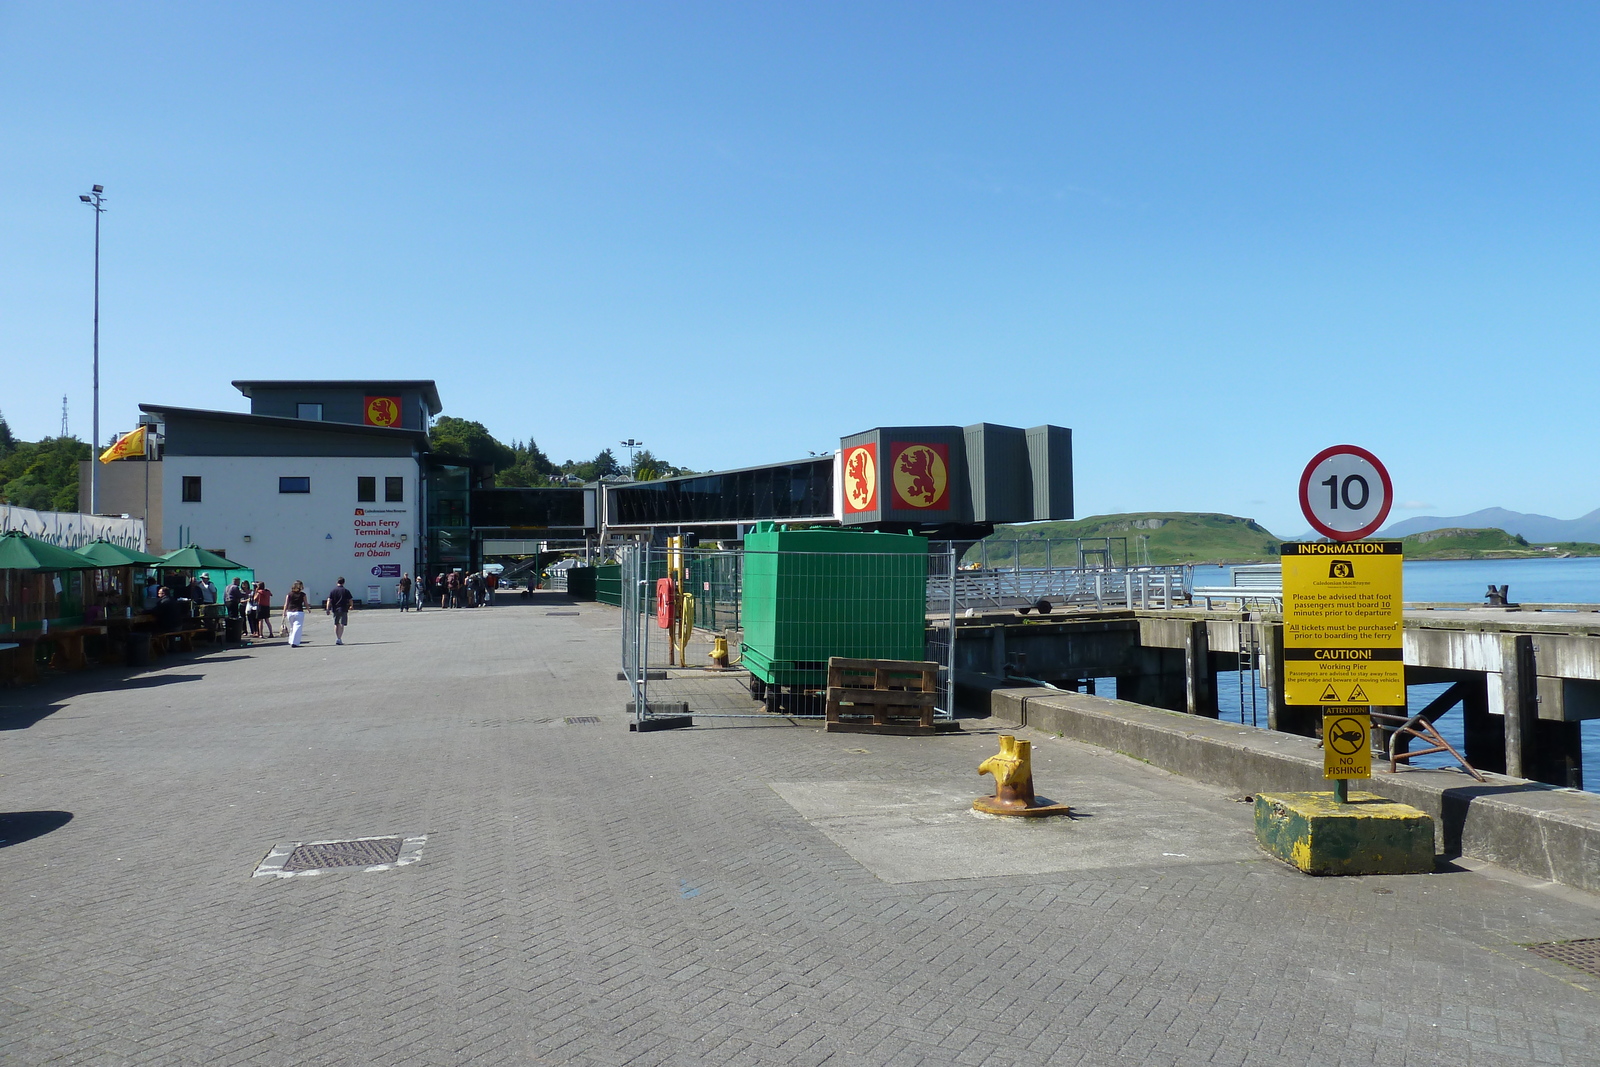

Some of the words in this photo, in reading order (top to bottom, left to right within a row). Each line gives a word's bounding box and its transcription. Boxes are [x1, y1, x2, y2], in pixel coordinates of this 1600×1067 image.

[1321, 474, 1370, 510] 10
[354, 519, 377, 527] Oban
[379, 519, 400, 529] Ferry
[354, 528, 391, 536] Terminal
[354, 541, 377, 549] Ionad
[379, 541, 401, 550] Aiseig
[1298, 543, 1384, 554] INFORMATION
[366, 548, 391, 557] Òbain
[1294, 602, 1335, 610] passengers
[1358, 624, 1396, 632] purchased
[1294, 632, 1312, 640] prior
[1324, 632, 1358, 640] boarding
[1374, 632, 1392, 640] ferry
[1314, 649, 1372, 660] CAUTION!
[1319, 663, 1351, 671] Working
[1339, 757, 1354, 765] NO
[1328, 766, 1366, 775] FISHING!
